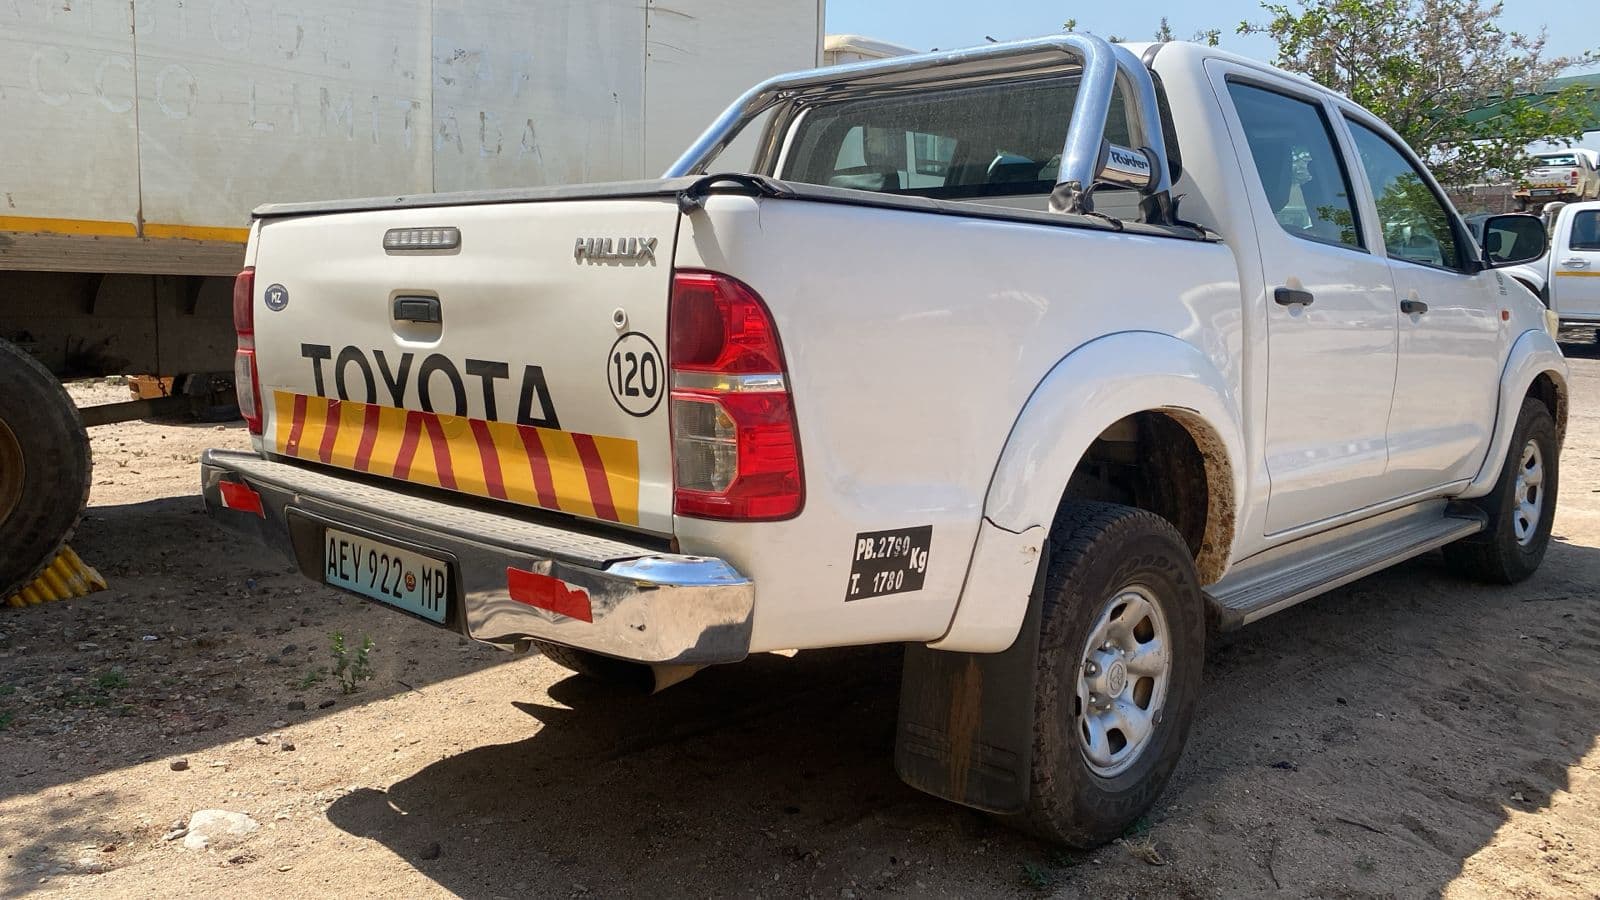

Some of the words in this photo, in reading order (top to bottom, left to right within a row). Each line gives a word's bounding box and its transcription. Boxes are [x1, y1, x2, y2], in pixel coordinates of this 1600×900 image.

[574, 237, 658, 261] HILUX
[271, 291, 282, 304] MZ
[301, 343, 562, 430] TOYOTA
[613, 352, 658, 398] 120
[909, 546, 927, 573] Kg
[327, 537, 362, 583] AEY
[368, 549, 403, 599] 922
[421, 565, 445, 612] MP
[873, 569, 904, 593] 1780
